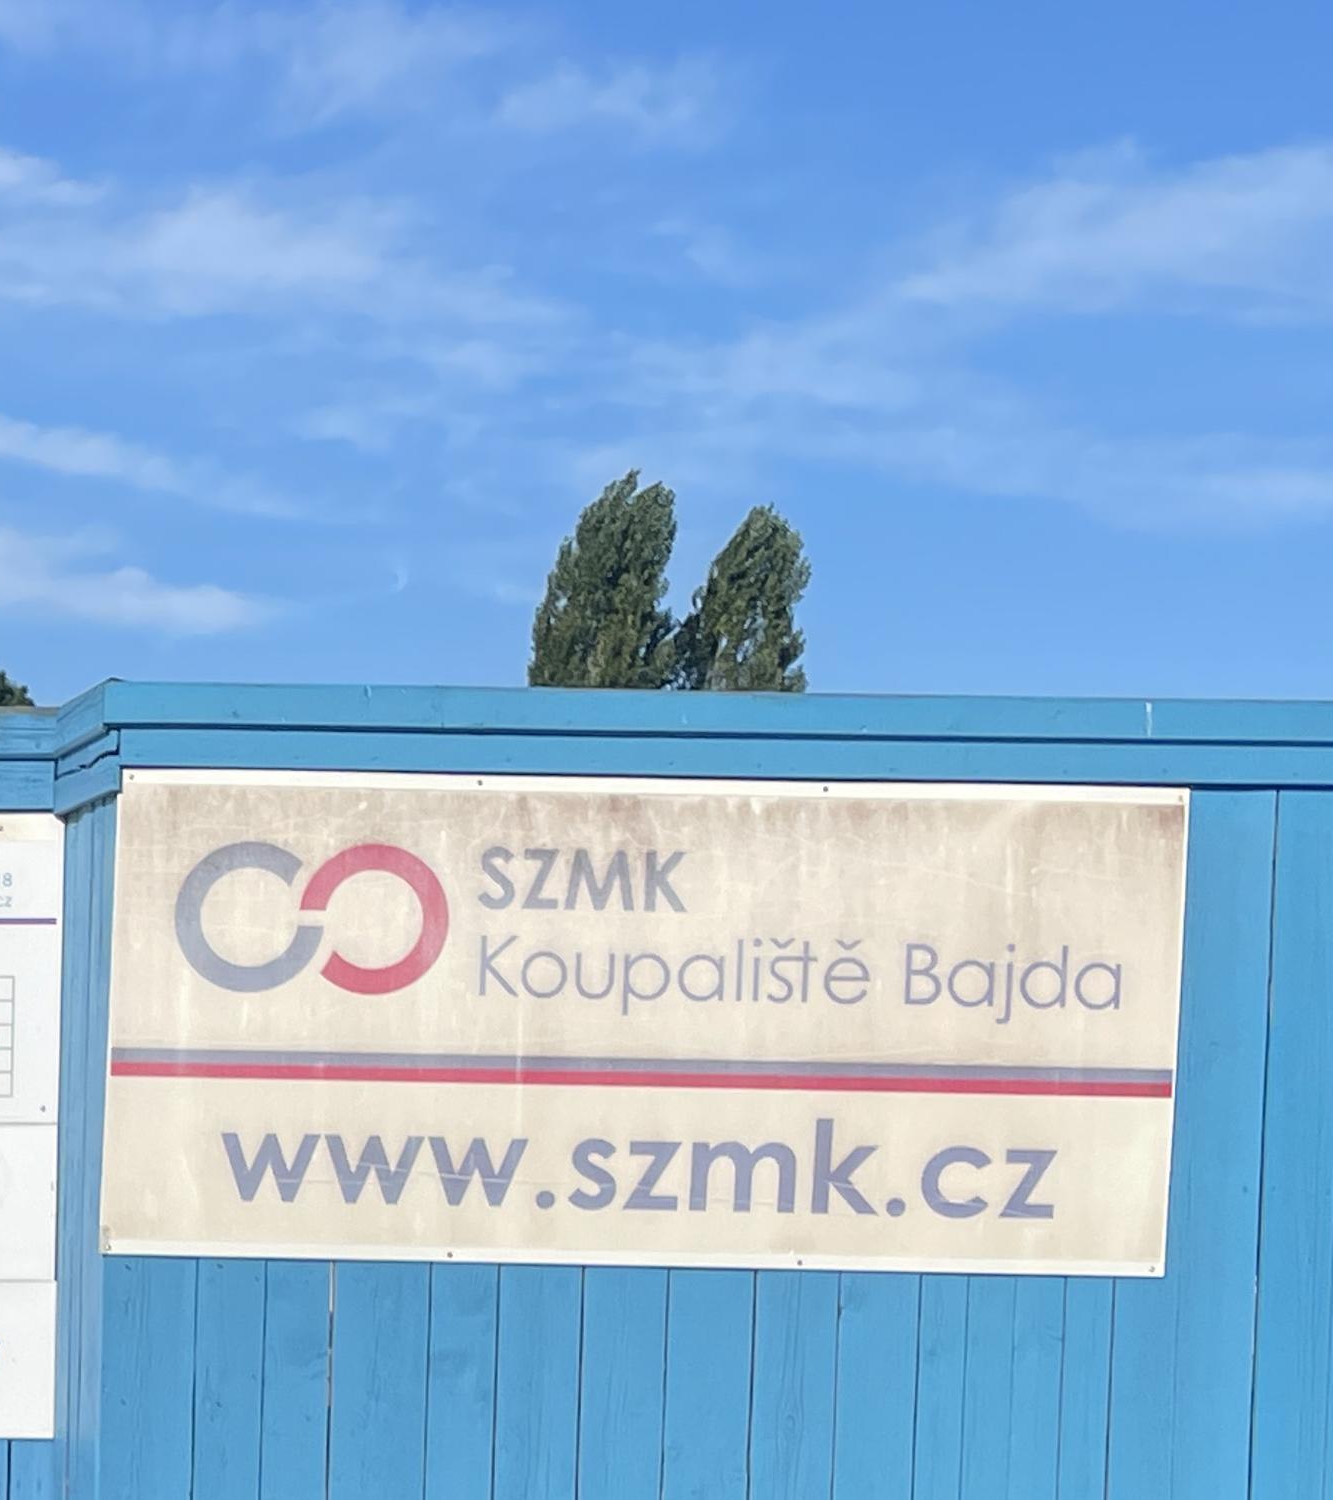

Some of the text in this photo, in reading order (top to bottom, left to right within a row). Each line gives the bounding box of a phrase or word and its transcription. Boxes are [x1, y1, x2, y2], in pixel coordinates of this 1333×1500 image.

[478, 845, 688, 913] SZMK
[476, 934, 1126, 1026] Koupaliště Bajda
[220, 1118, 1059, 1220] www.szmk.cz
